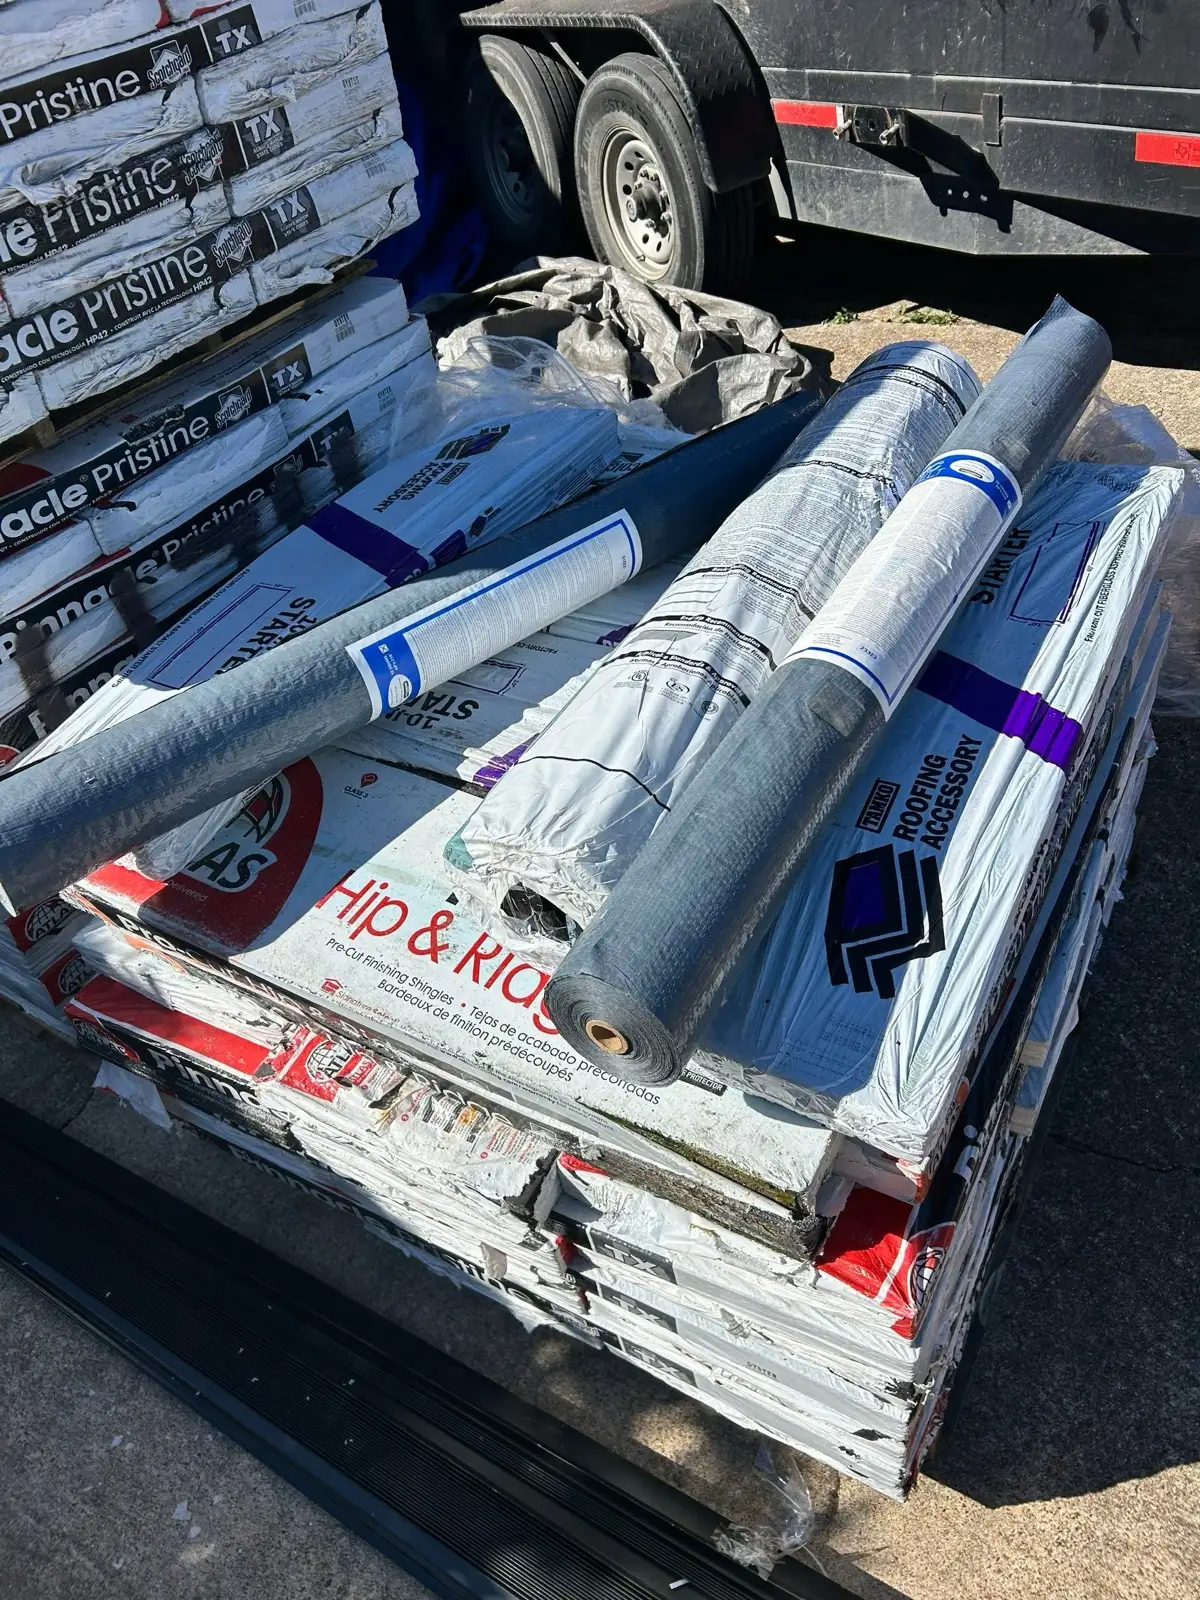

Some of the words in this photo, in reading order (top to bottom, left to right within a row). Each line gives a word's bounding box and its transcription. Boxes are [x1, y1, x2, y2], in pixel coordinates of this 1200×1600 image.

[215, 25, 252, 54] TX
[147, 44, 194, 90] Scotchgard
[0, 70, 141, 139] Pristine
[245, 109, 281, 144] TX
[271, 191, 307, 224] TX
[80, 245, 208, 330] Pristine
[272, 360, 303, 388] TX
[214, 386, 252, 429] Scotchgard
[91, 415, 210, 493] Pristine
[1099, 568, 1117, 606] FIBERGLASS
[132, 643, 160, 670] STARTER
[751, 648, 766, 664] final
[861, 783, 895, 831] TAMKO
[892, 754, 948, 842] ROOFING
[919, 733, 982, 850] ACCESSORY
[315, 868, 410, 941] Hip
[407, 909, 456, 965] &
[326, 937, 364, 961] Pre-Cut
[362, 953, 410, 985] Finishing
[408, 976, 455, 1006] Shingles
[469, 1005, 500, 1029] Tejas
[499, 1021, 517, 1037] de
[517, 1031, 578, 1065] acabado
[377, 979, 431, 1014] Bardeaux
[432, 1003, 450, 1021] de
[449, 1013, 490, 1045] finition
[488, 1032, 575, 1084] prédécoupés
[686, 1071, 724, 1092] PROTECTOR
